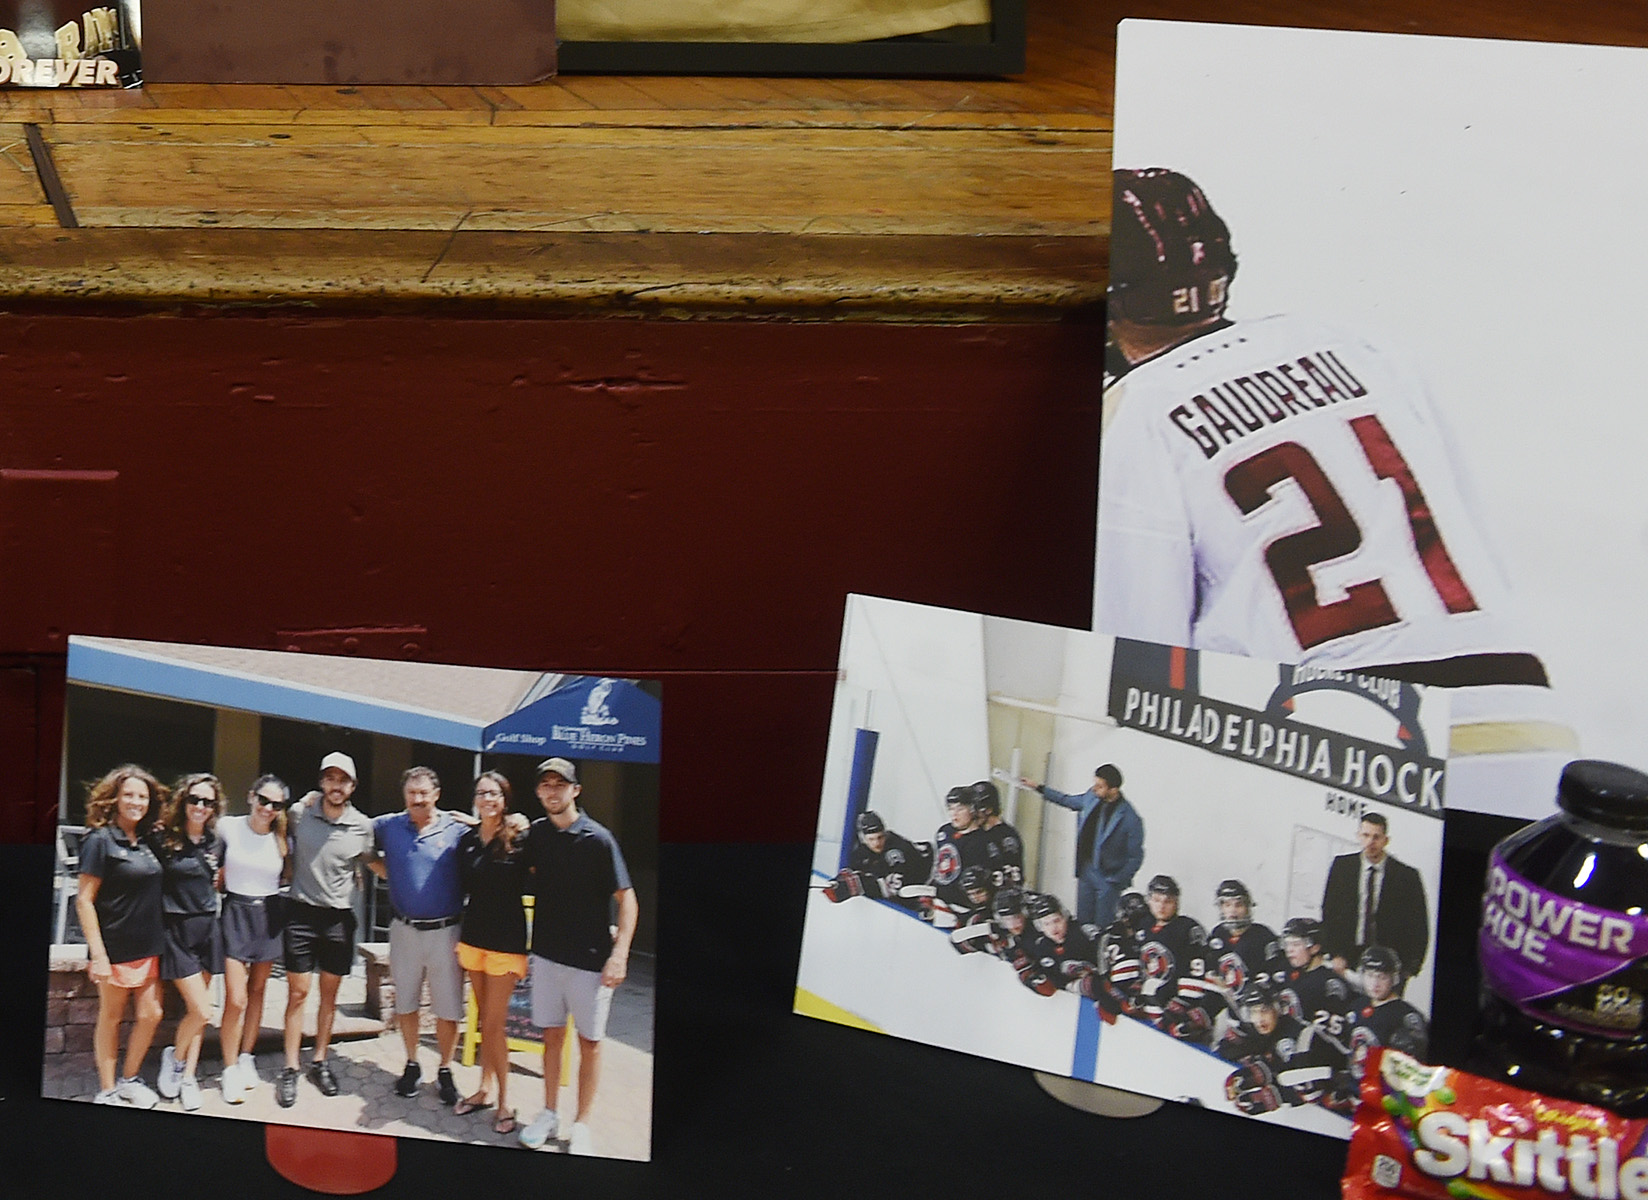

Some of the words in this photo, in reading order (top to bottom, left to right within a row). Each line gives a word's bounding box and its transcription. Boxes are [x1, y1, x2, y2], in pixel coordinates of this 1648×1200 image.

[1172, 286, 1200, 313] 21
[1169, 350, 1368, 460] GAUDREAU
[1223, 413, 1481, 652] 21
[1123, 687, 1332, 779] PHILADELPHIA
[1342, 746, 1445, 811] HOCK
[1489, 866, 1635, 955] POWER
